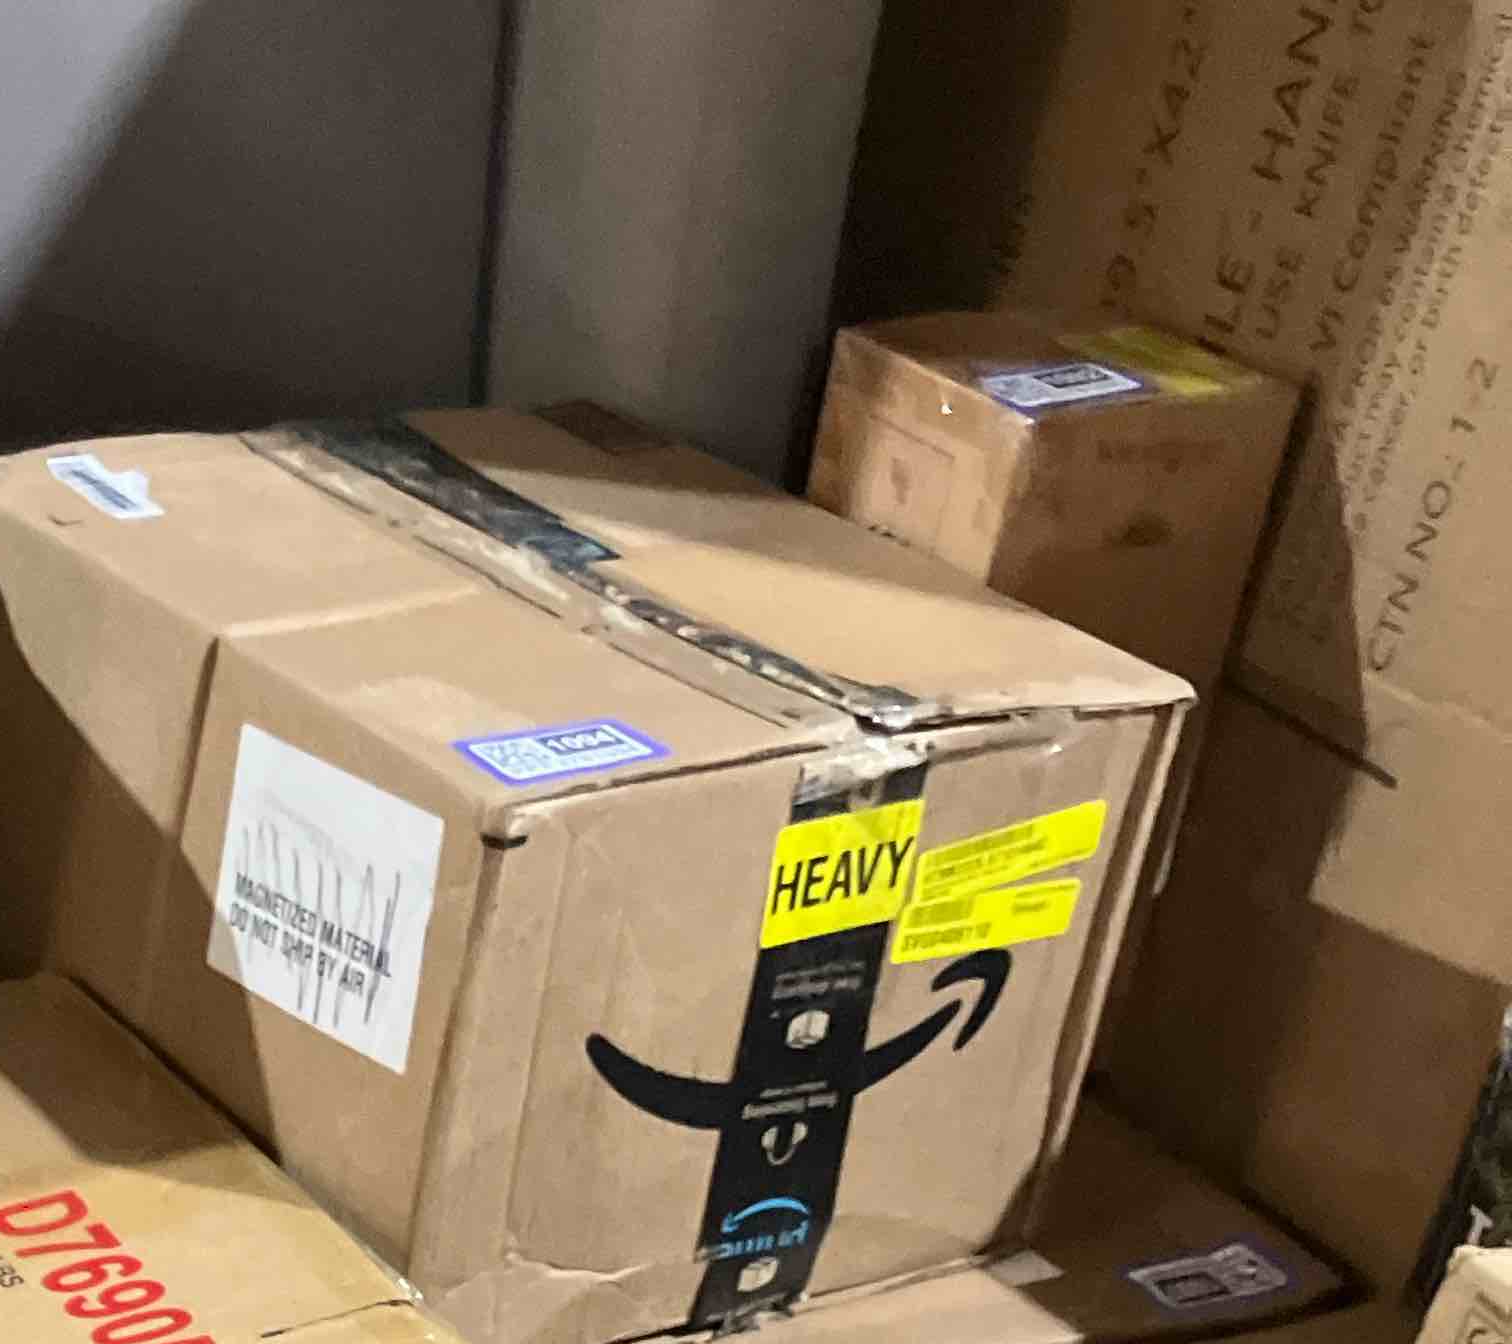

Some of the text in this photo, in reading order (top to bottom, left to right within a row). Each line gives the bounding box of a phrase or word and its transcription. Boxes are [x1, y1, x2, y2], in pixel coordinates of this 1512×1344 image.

[1251, 0, 1337, 182] HAN
[1368, 571, 1420, 672] CTN
[235, 871, 317, 938] MAGNETIZED
[771, 835, 914, 916] HEAVY
